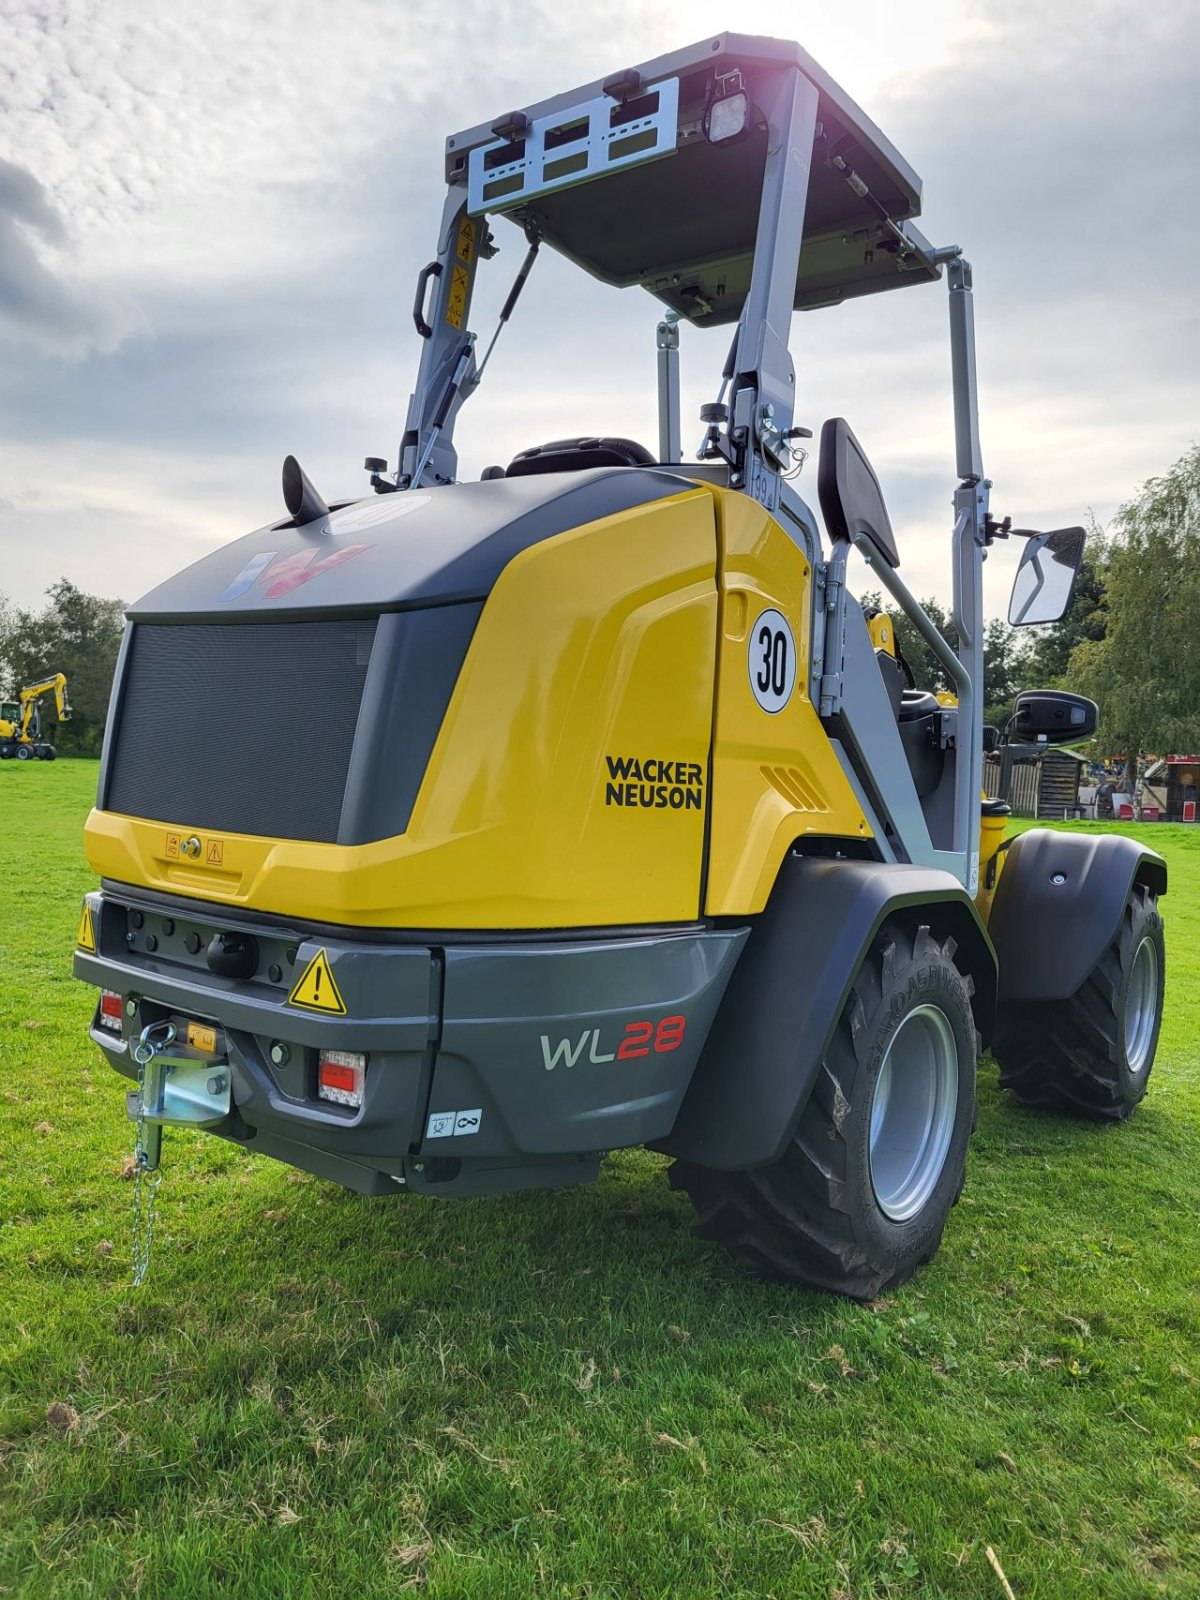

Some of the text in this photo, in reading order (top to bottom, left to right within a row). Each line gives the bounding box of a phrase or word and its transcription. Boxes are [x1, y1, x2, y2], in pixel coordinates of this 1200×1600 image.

[757, 625, 787, 697] 30
[605, 755, 703, 786] WACKER
[605, 783, 702, 810] NEUSON
[540, 1015, 686, 1071] WL28
